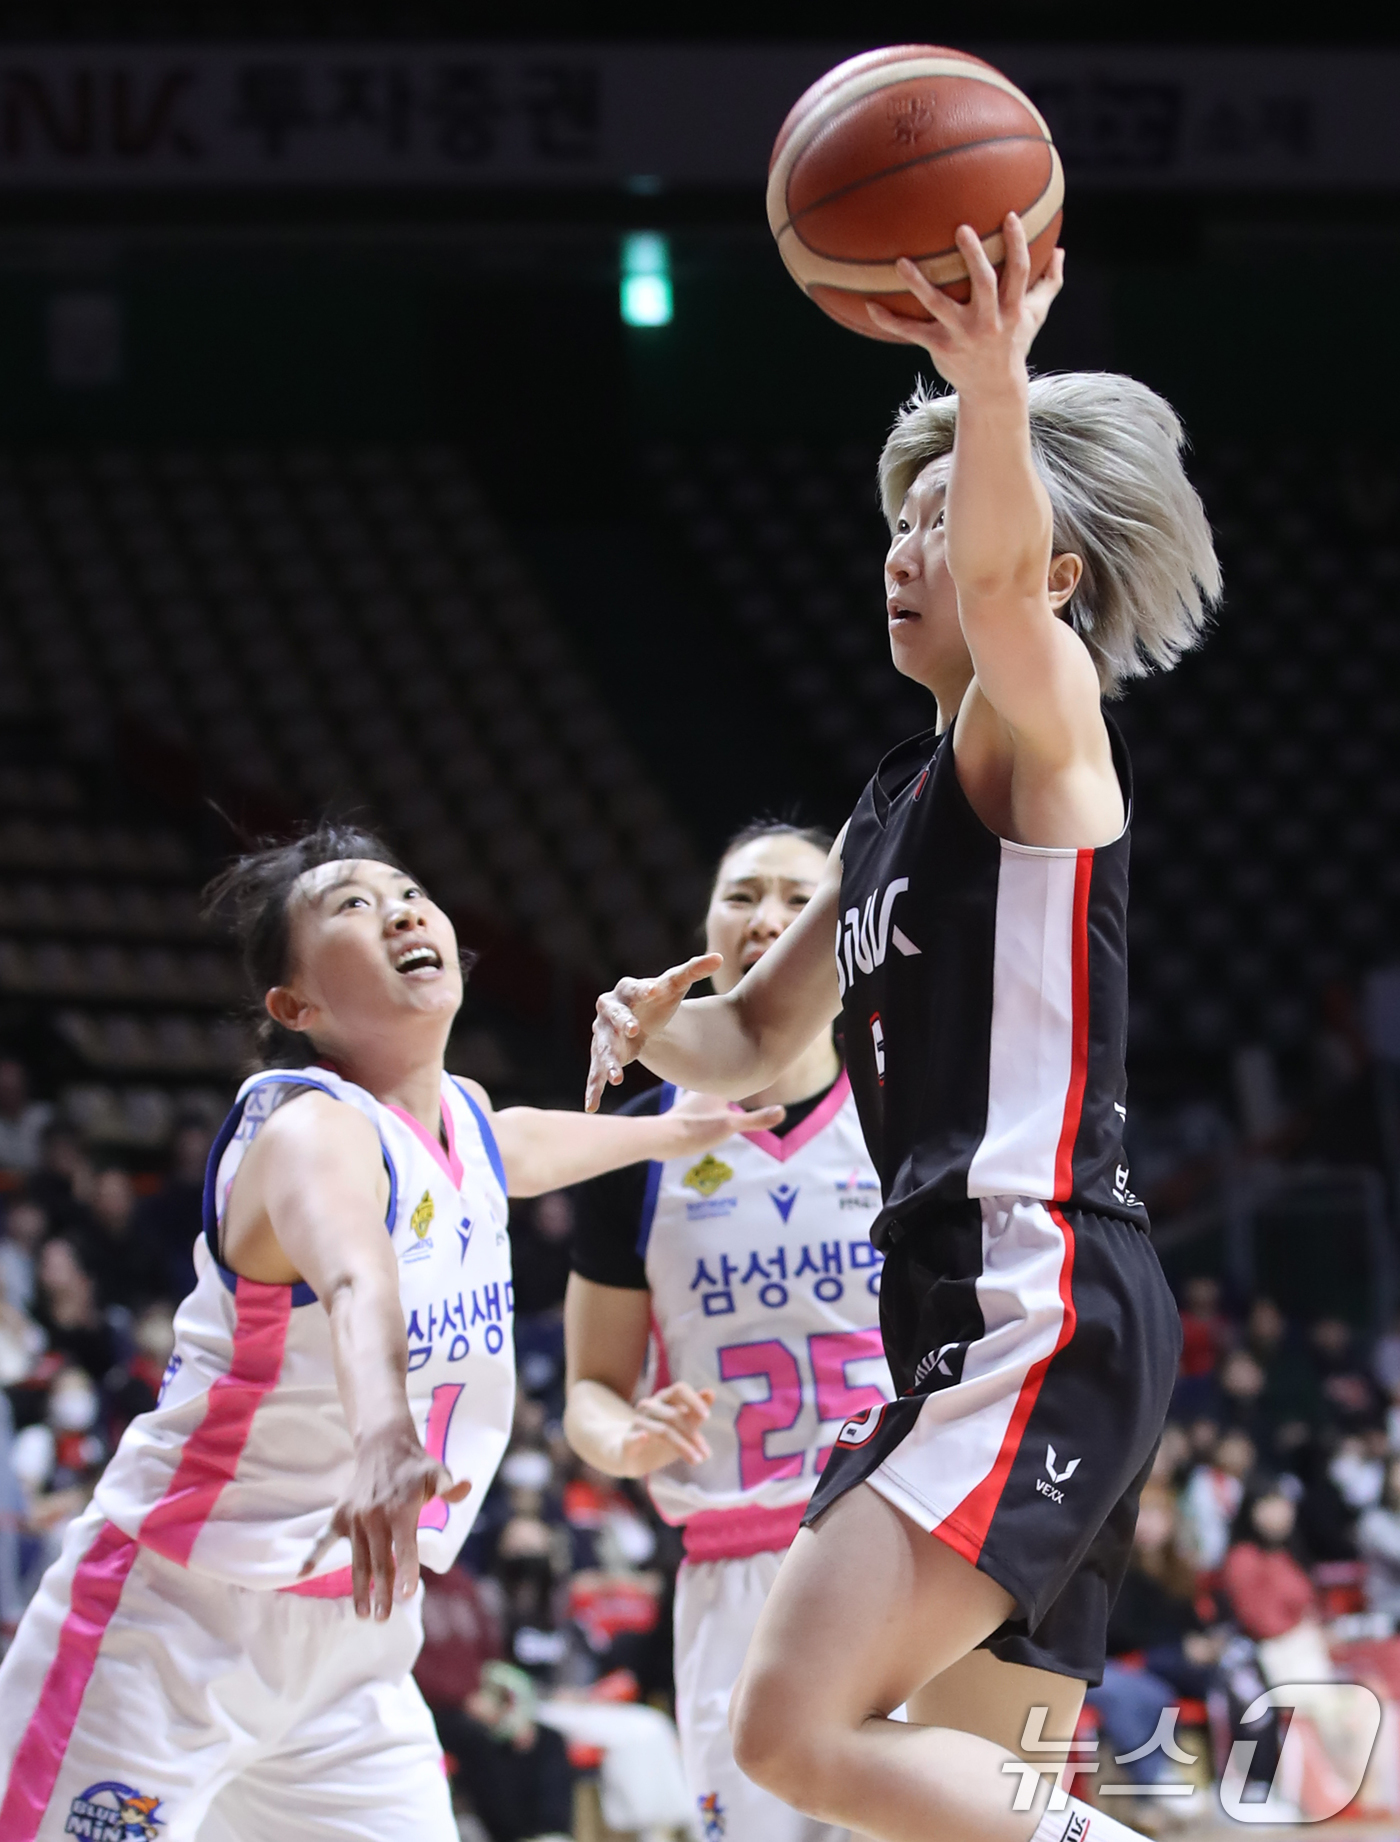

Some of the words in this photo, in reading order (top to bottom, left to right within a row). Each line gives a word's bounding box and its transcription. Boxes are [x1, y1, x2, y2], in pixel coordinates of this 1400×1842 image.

[228, 62, 601, 164] 투자증권
[717, 1327, 888, 1492] 25
[1036, 1479, 1065, 1505] VEXX
[71, 1797, 121, 1825] BLUE
